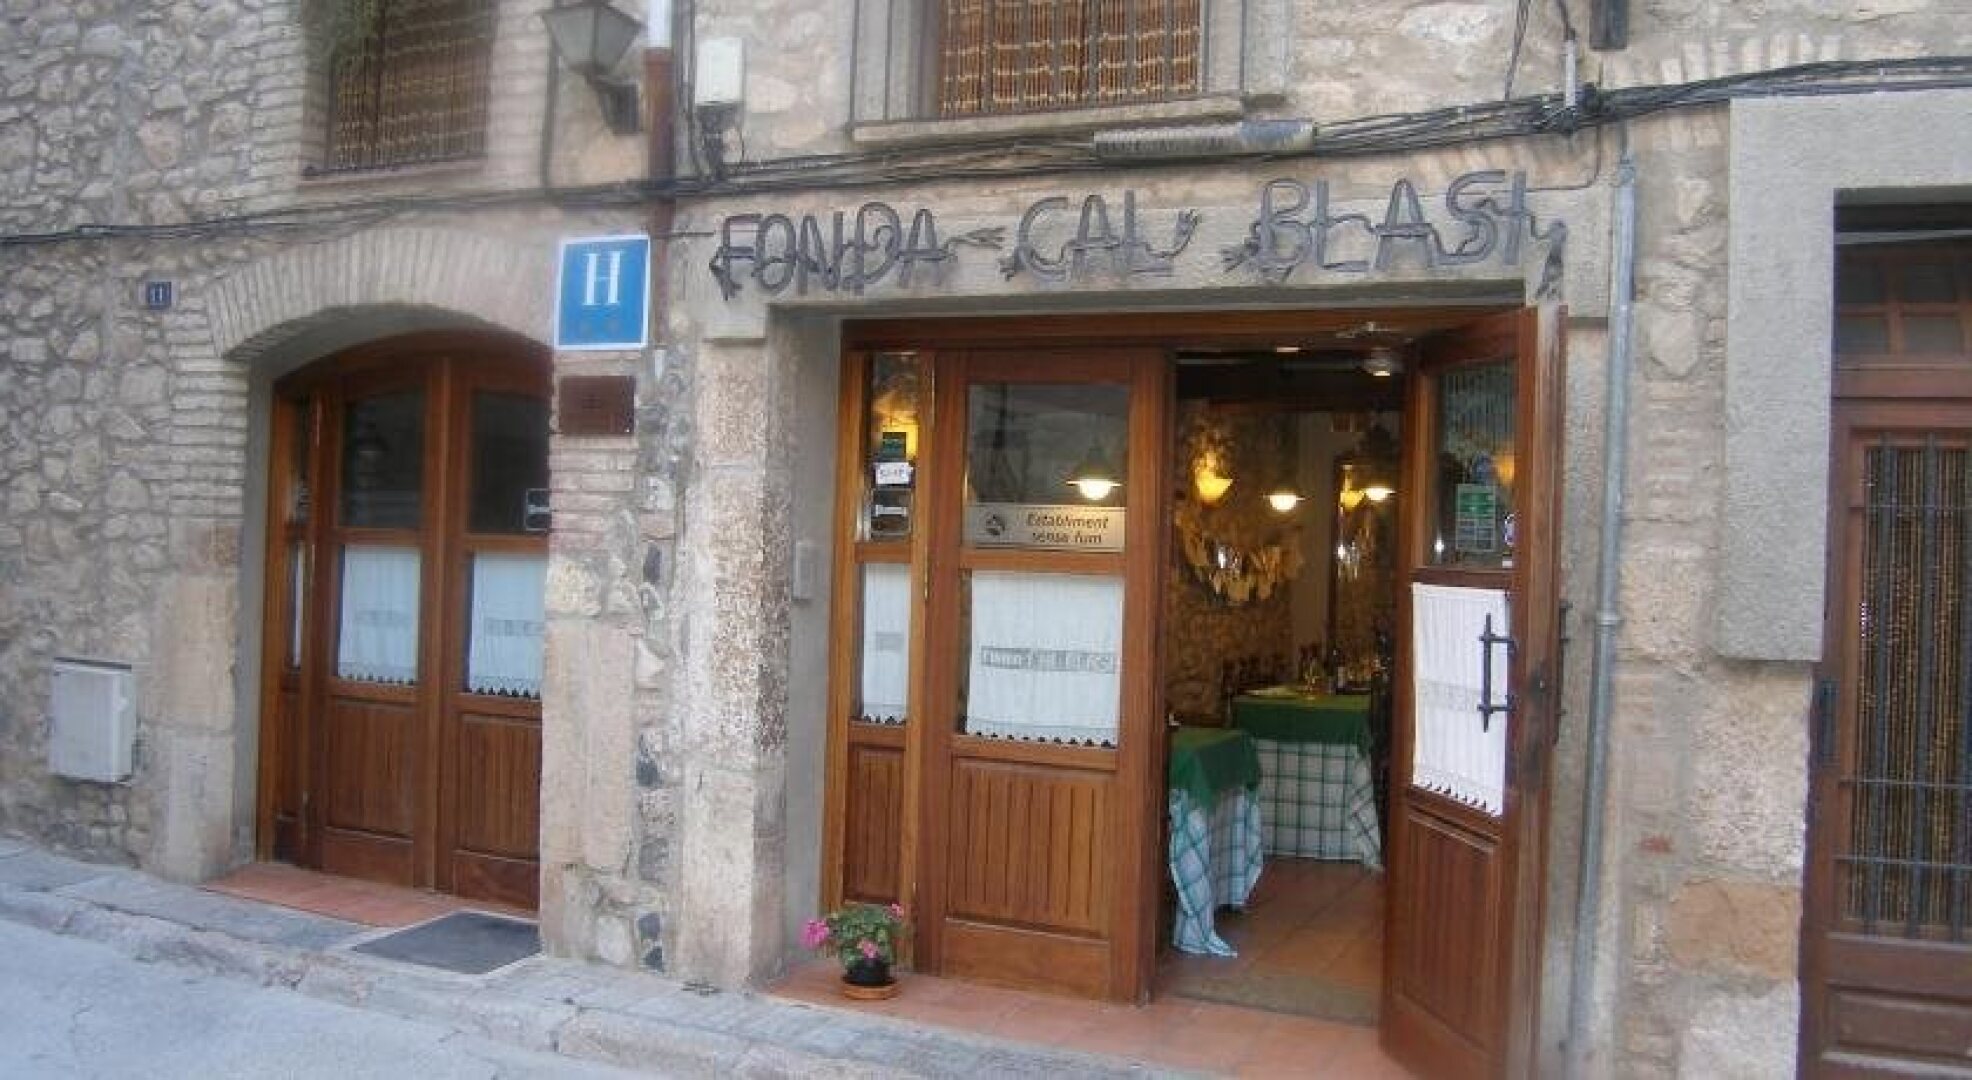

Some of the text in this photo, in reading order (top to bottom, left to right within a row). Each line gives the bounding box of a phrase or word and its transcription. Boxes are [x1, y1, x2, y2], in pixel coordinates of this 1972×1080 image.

[718, 202, 946, 296] FONDA
[1014, 190, 1174, 282] CAL
[583, 251, 622, 306] H
[1027, 513, 1109, 529] Establiment
